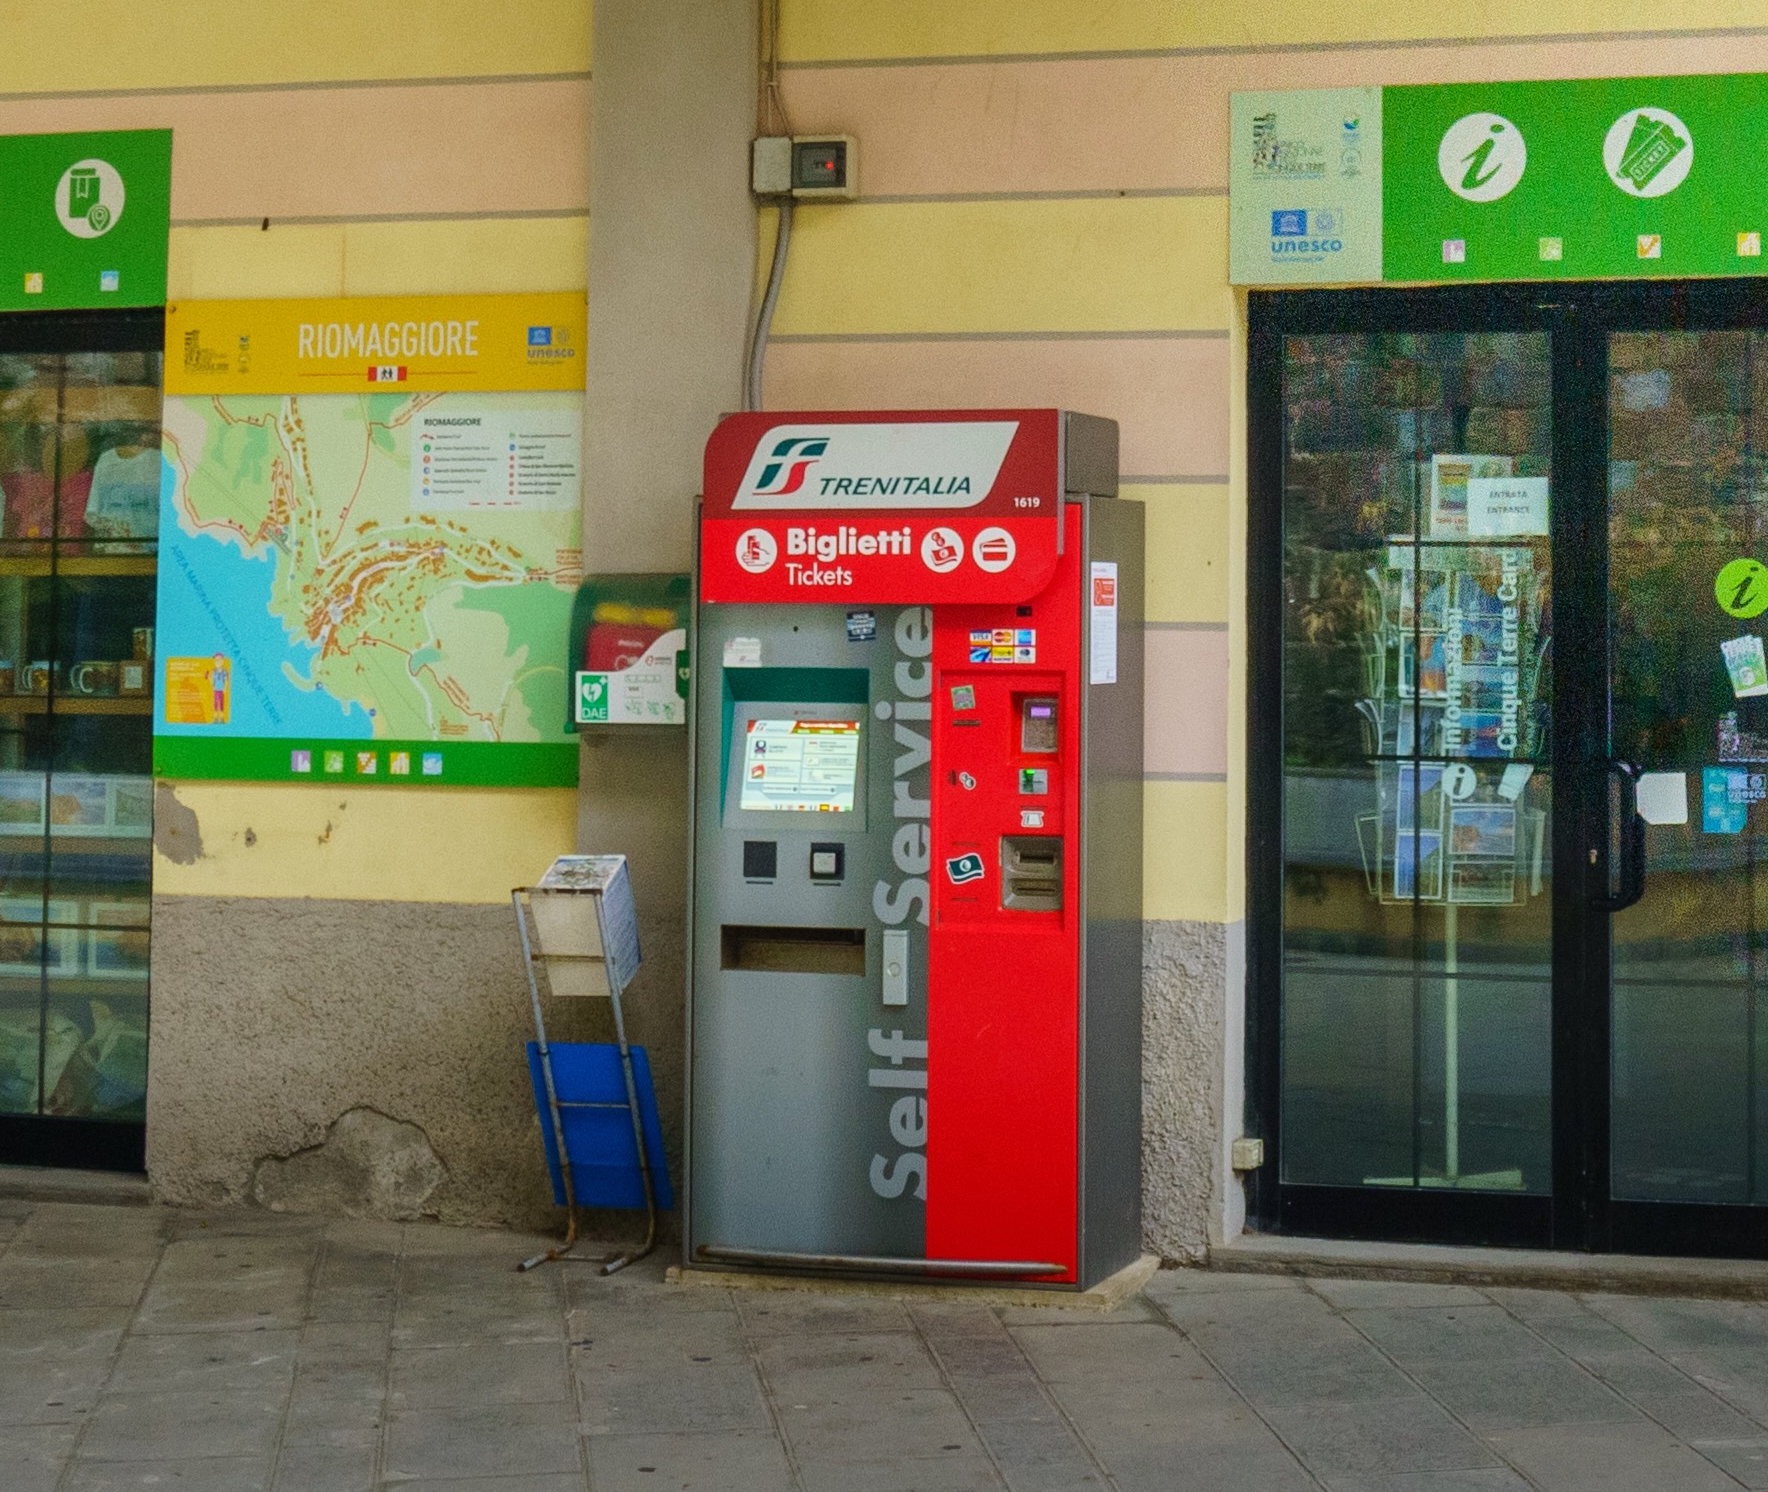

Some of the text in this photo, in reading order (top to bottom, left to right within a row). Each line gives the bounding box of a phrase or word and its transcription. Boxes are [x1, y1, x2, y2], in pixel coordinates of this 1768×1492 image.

[1271, 239, 1343, 253] unesco
[298, 320, 479, 359] RIOMAGGIORE
[424, 418, 481, 427] RIOMAGGIORE
[819, 476, 971, 495] TRENITALIA
[1013, 496, 1040, 508] 1619
[786, 526, 912, 562] Biglietti
[785, 563, 853, 586] Tickets
[1497, 607, 1519, 667] Terre
[582, 707, 607, 719] DAE
[1497, 671, 1522, 752] Cinque
[868, 608, 933, 1201] Self Service
